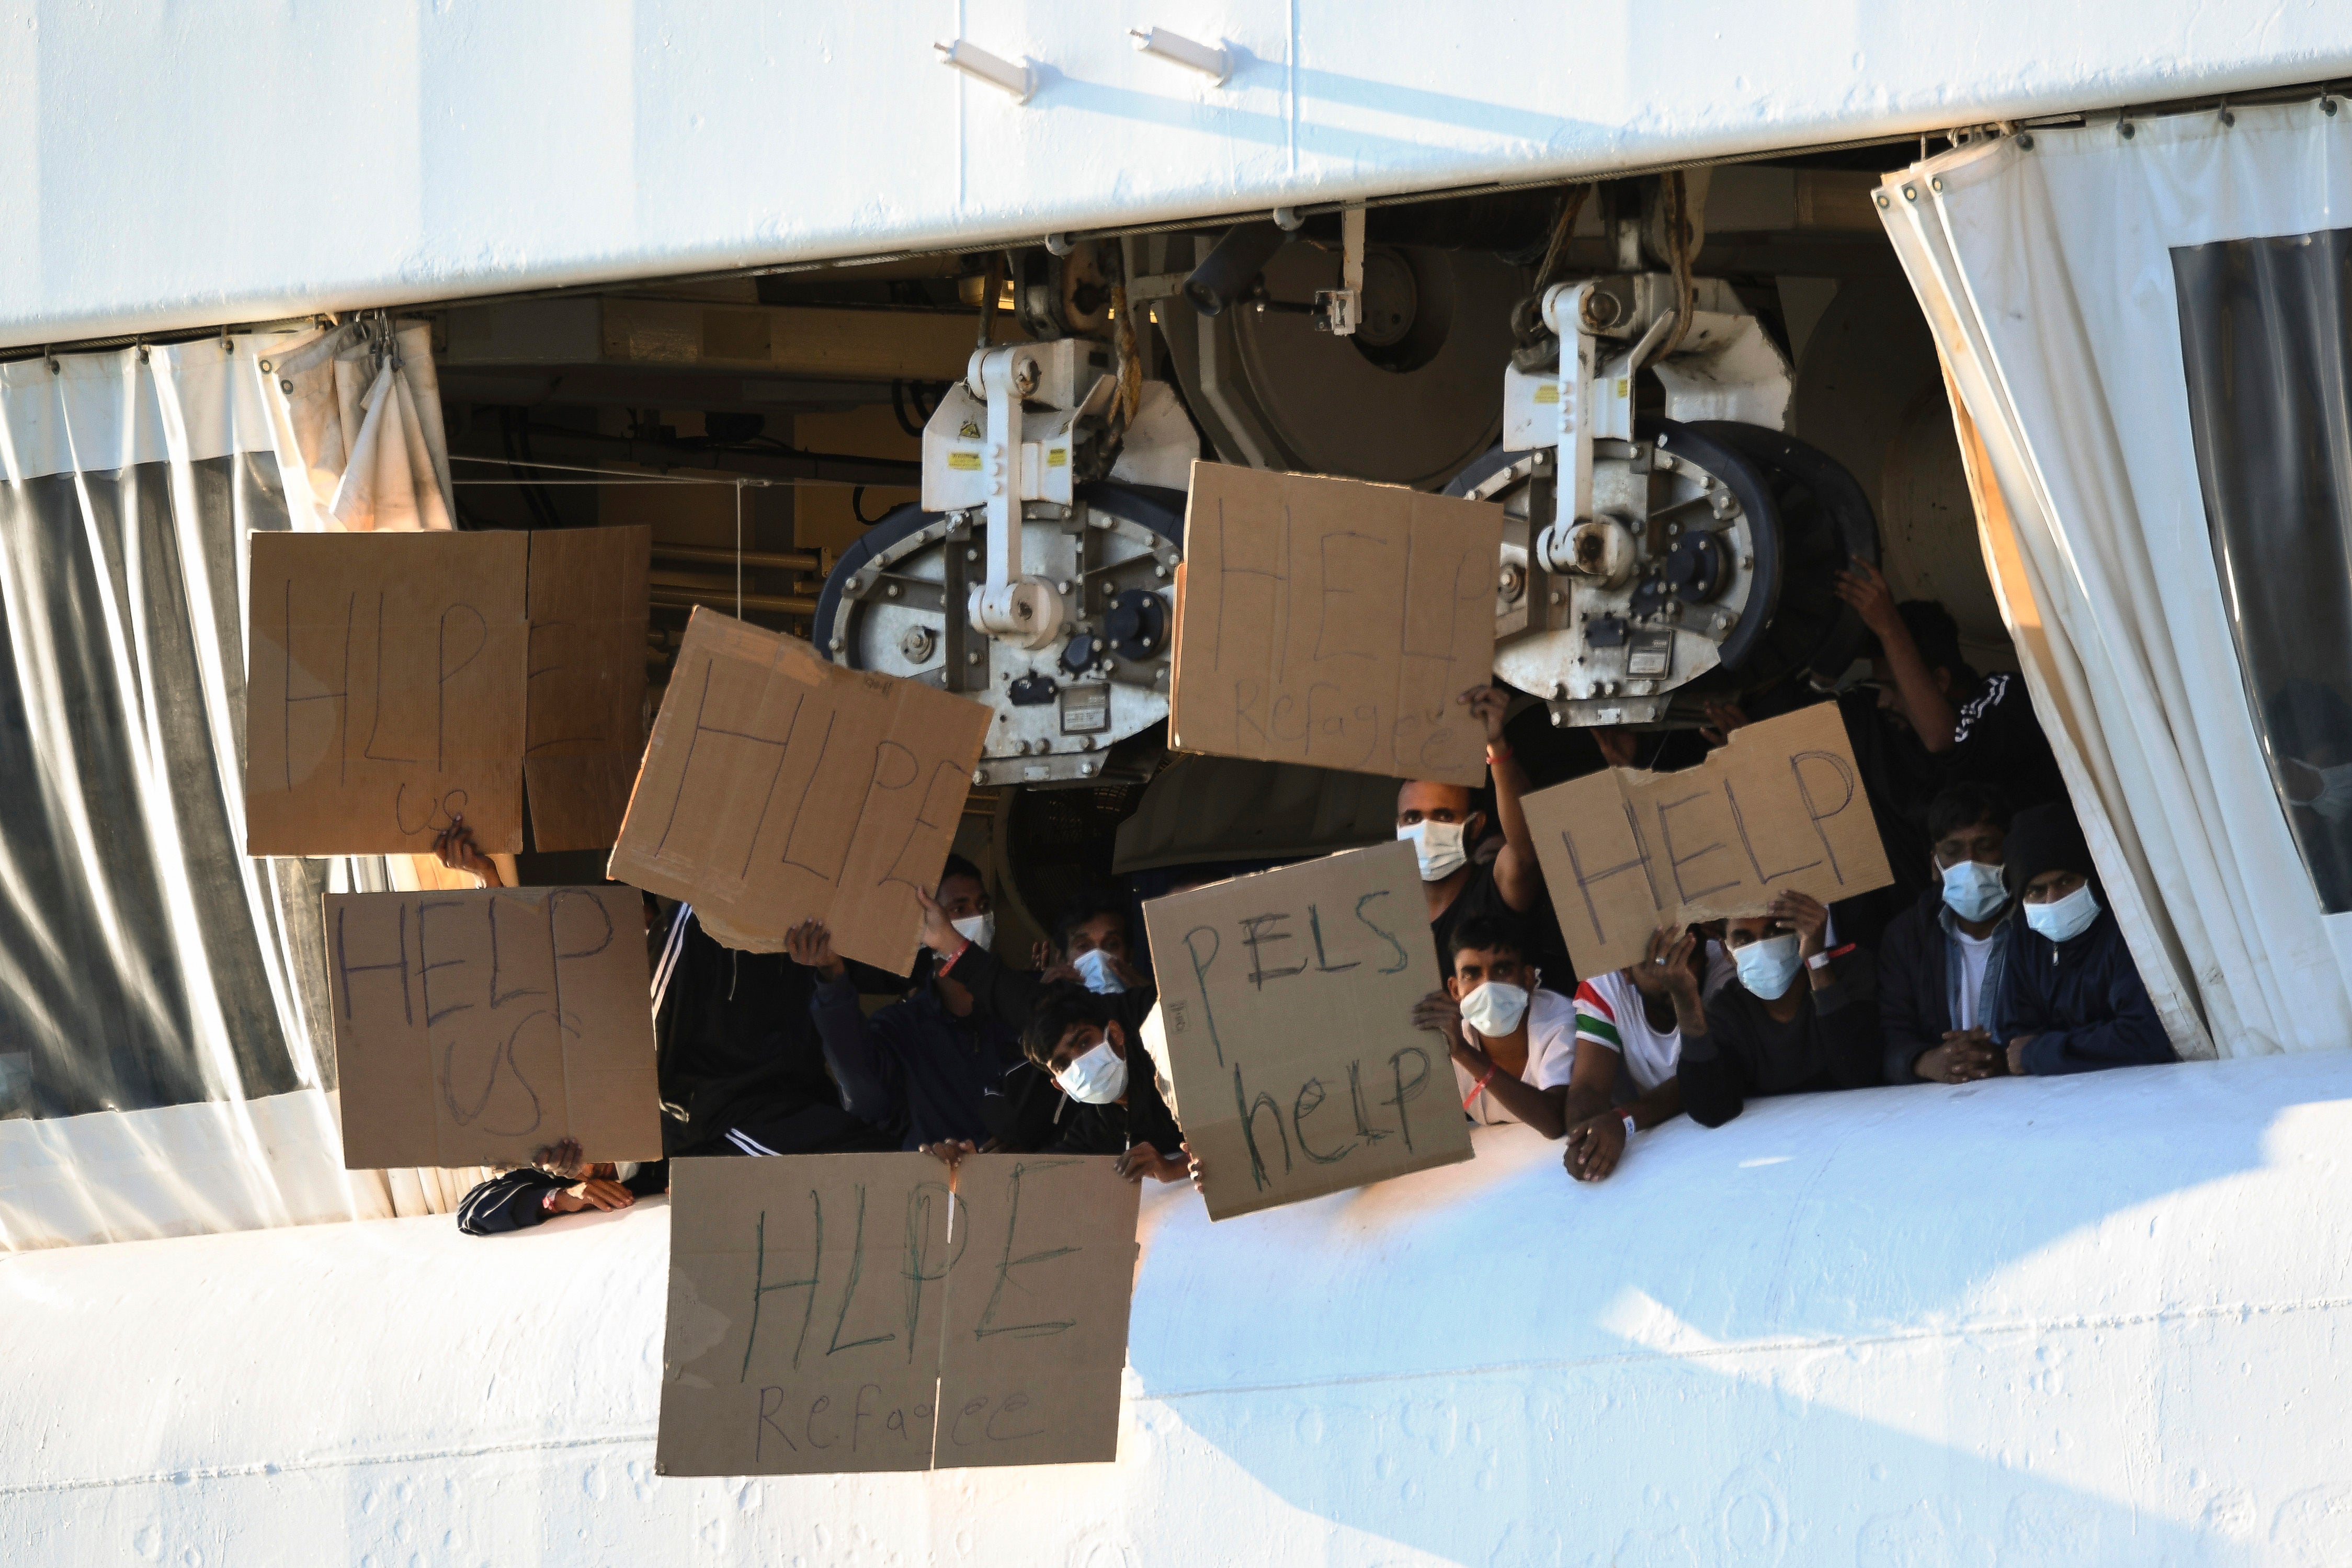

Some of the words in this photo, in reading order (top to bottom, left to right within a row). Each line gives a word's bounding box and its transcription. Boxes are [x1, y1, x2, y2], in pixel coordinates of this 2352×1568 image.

[1214, 498, 1492, 717] HELP
[1562, 751, 1854, 945] HELP
[336, 889, 613, 1028] HELP
[1181, 890, 1408, 1067] PELS
[442, 1009, 582, 1137] US
[741, 1160, 1086, 1383] HLPE
